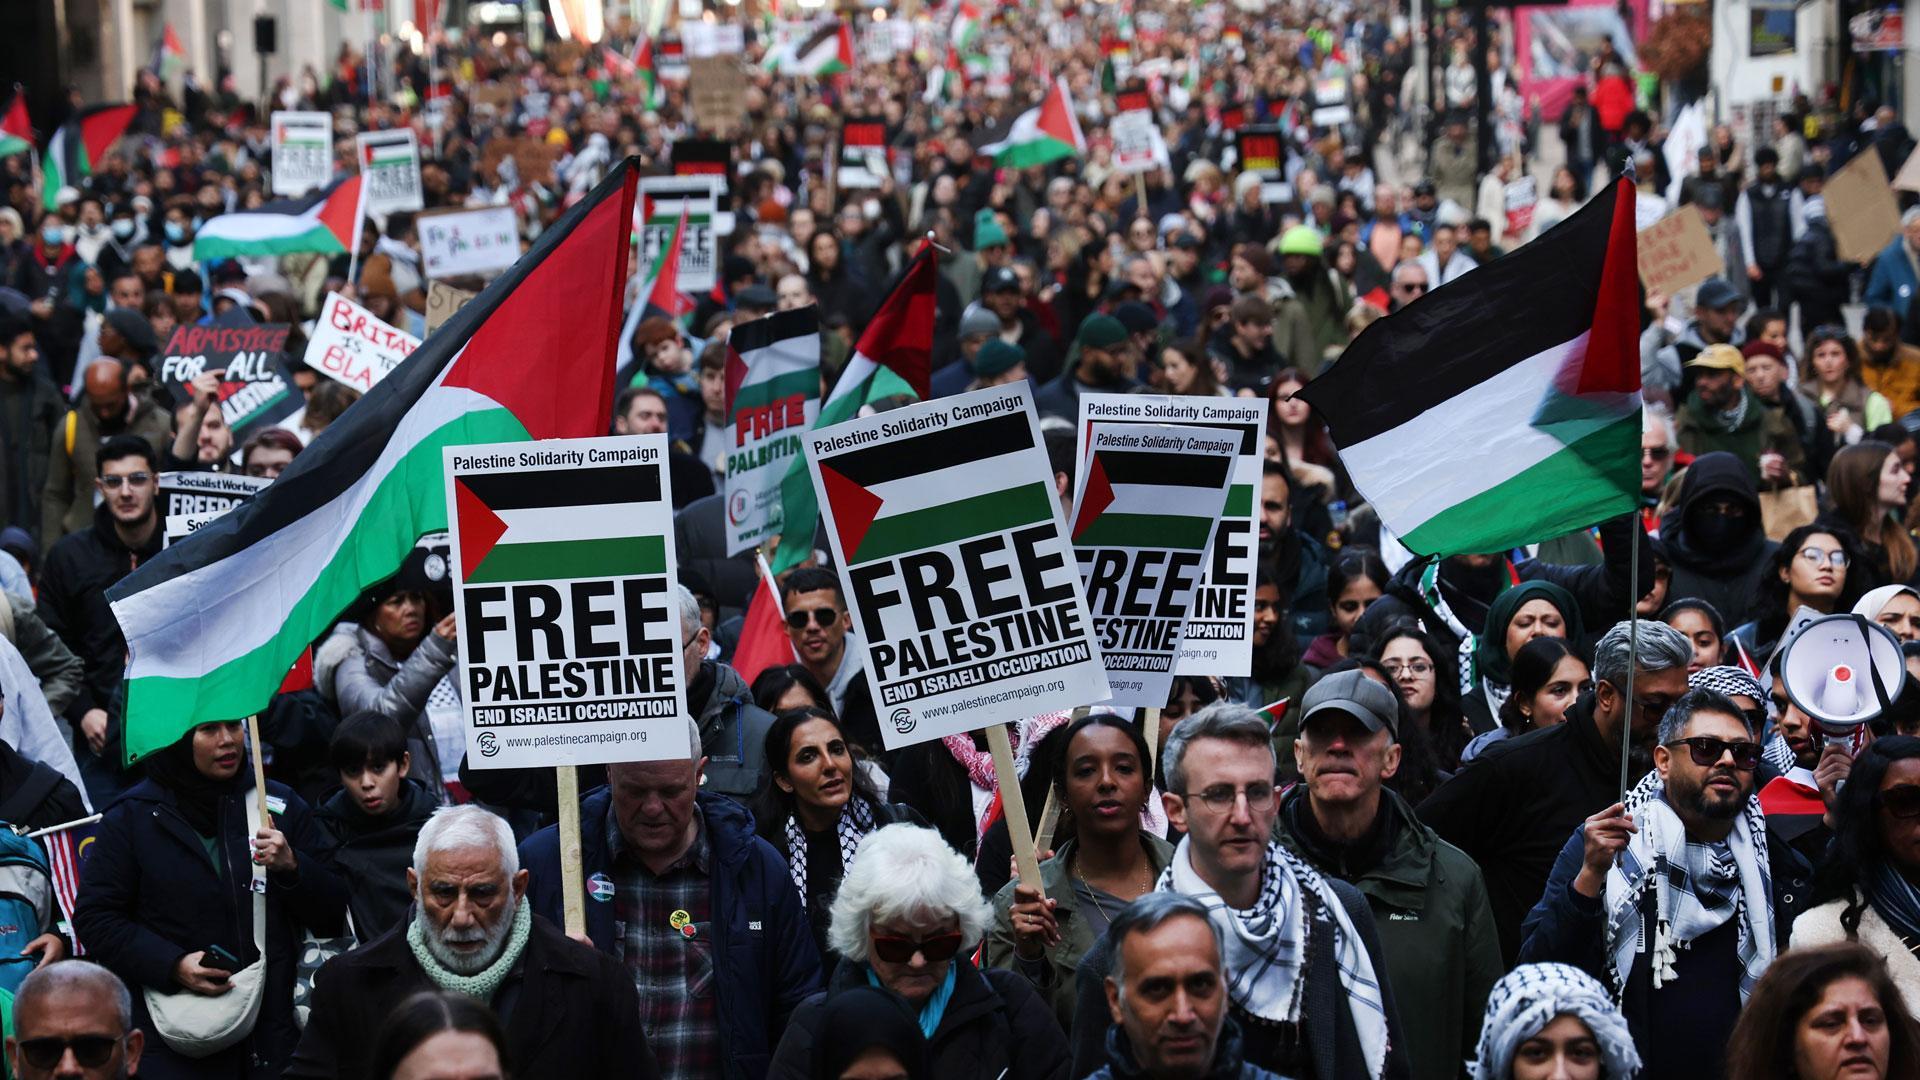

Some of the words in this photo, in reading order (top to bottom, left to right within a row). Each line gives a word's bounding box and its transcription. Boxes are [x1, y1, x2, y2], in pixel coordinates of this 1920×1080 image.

[429, 282, 471, 313] ST
[165, 325, 290, 354] ARMISTICE
[343, 335, 362, 353] IS
[161, 355, 206, 383] FOR
[735, 393, 806, 448] FREE
[813, 426, 880, 455] Palestine
[881, 411, 949, 439] Solidarity
[952, 394, 1024, 422] Campaign
[1088, 403, 1141, 417] Palestine
[1144, 404, 1199, 420] Solidarity
[1202, 406, 1259, 421] Campaign
[1096, 433, 1139, 448] Palestine
[1141, 435, 1185, 450] Solidarity
[1187, 437, 1234, 453] Campaign
[454, 454, 515, 470] Palestine
[519, 451, 584, 467] Solidarity
[588, 447, 659, 464] Campaign
[177, 475, 221, 489] Socialist
[222, 479, 258, 493] Worker
[169, 493, 243, 516] FREED
[1200, 520, 1250, 585] E
[848, 523, 1075, 645] FREE
[463, 577, 674, 664] FREE
[869, 600, 1086, 683] PALESTINE
[883, 682, 918, 705] END
[922, 664, 985, 696] ISRAELI
[988, 644, 1088, 680] OCCUPATION
[1104, 654, 1169, 671] OCCUPATION
[469, 656, 676, 703] PALESTINE
[474, 708, 506, 725] END
[510, 703, 571, 724] ISRAELI
[574, 699, 675, 721] OCCUPATION
[921, 679, 1065, 720] www.palestinecampaign.org
[506, 730, 647, 748] www.palestinecampaign.org
